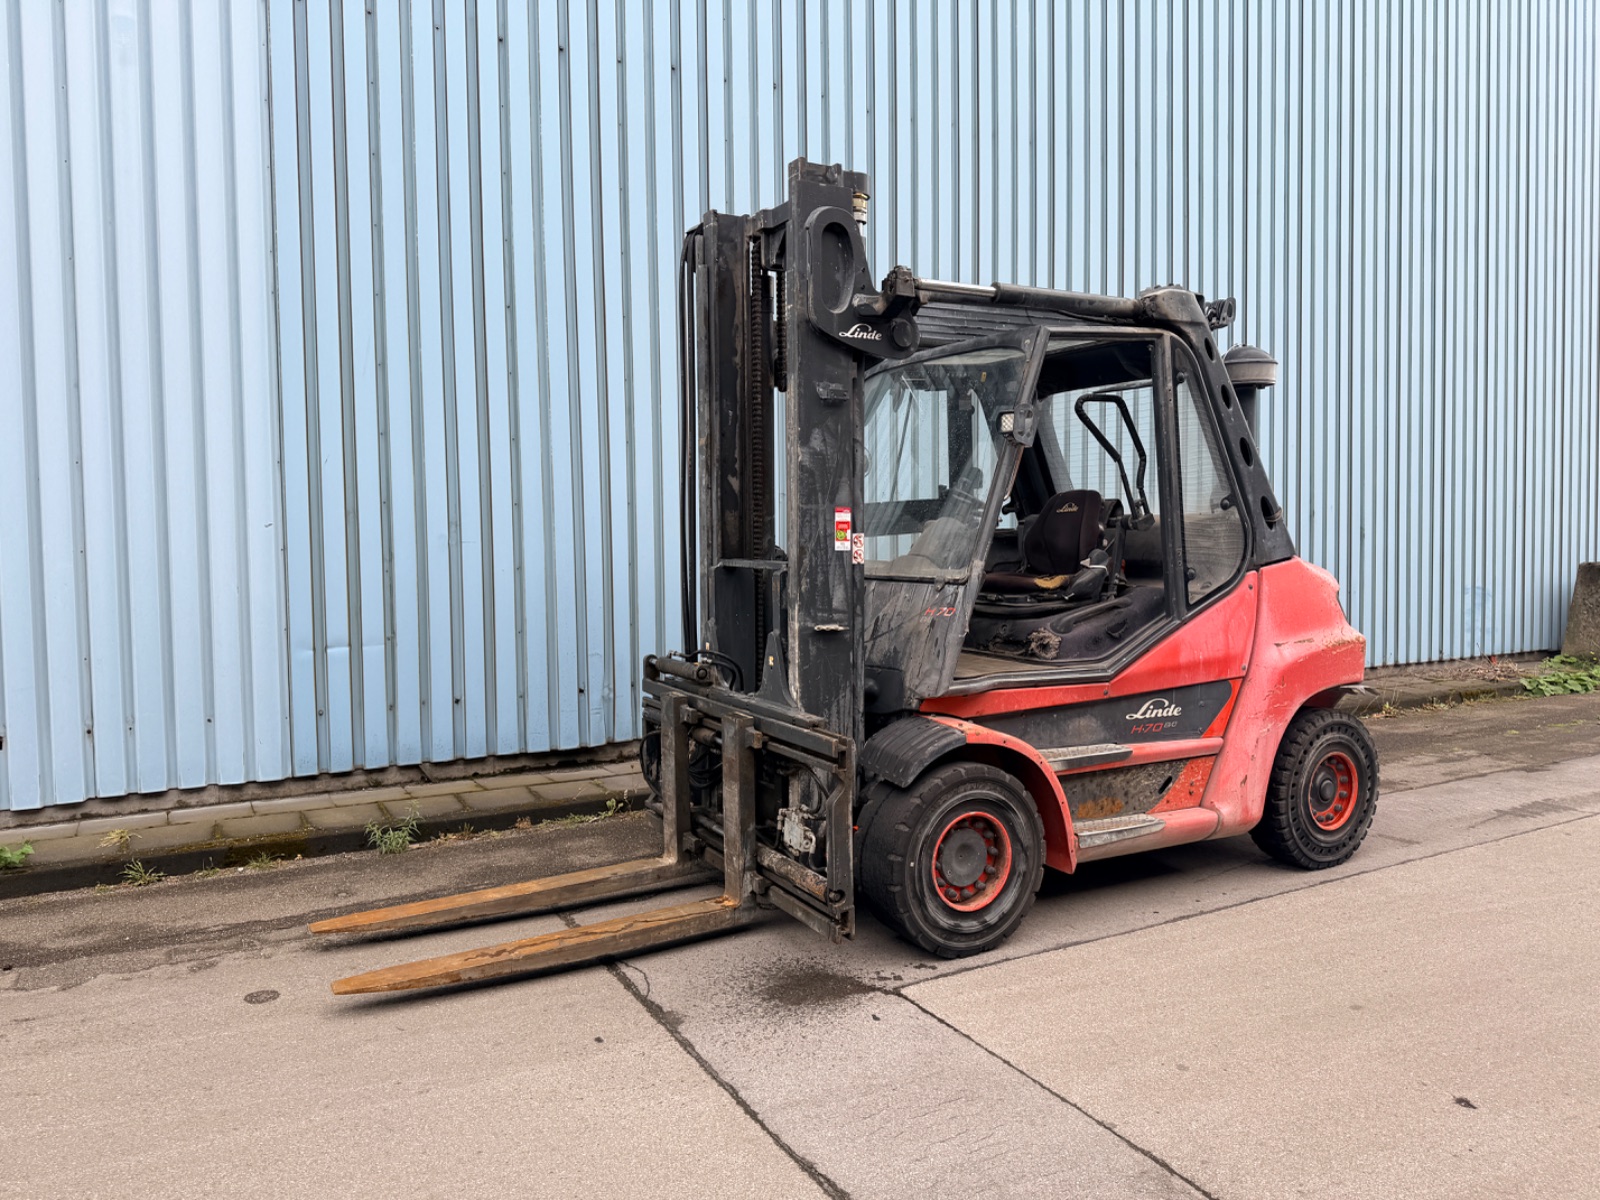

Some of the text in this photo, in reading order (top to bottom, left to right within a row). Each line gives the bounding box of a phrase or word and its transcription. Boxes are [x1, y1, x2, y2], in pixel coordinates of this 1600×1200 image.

[838, 323, 882, 341] Linde
[1056, 502, 1079, 513] Linde
[924, 607, 957, 617] H70
[1126, 698, 1182, 720] Linde
[1130, 723, 1164, 735] H70
